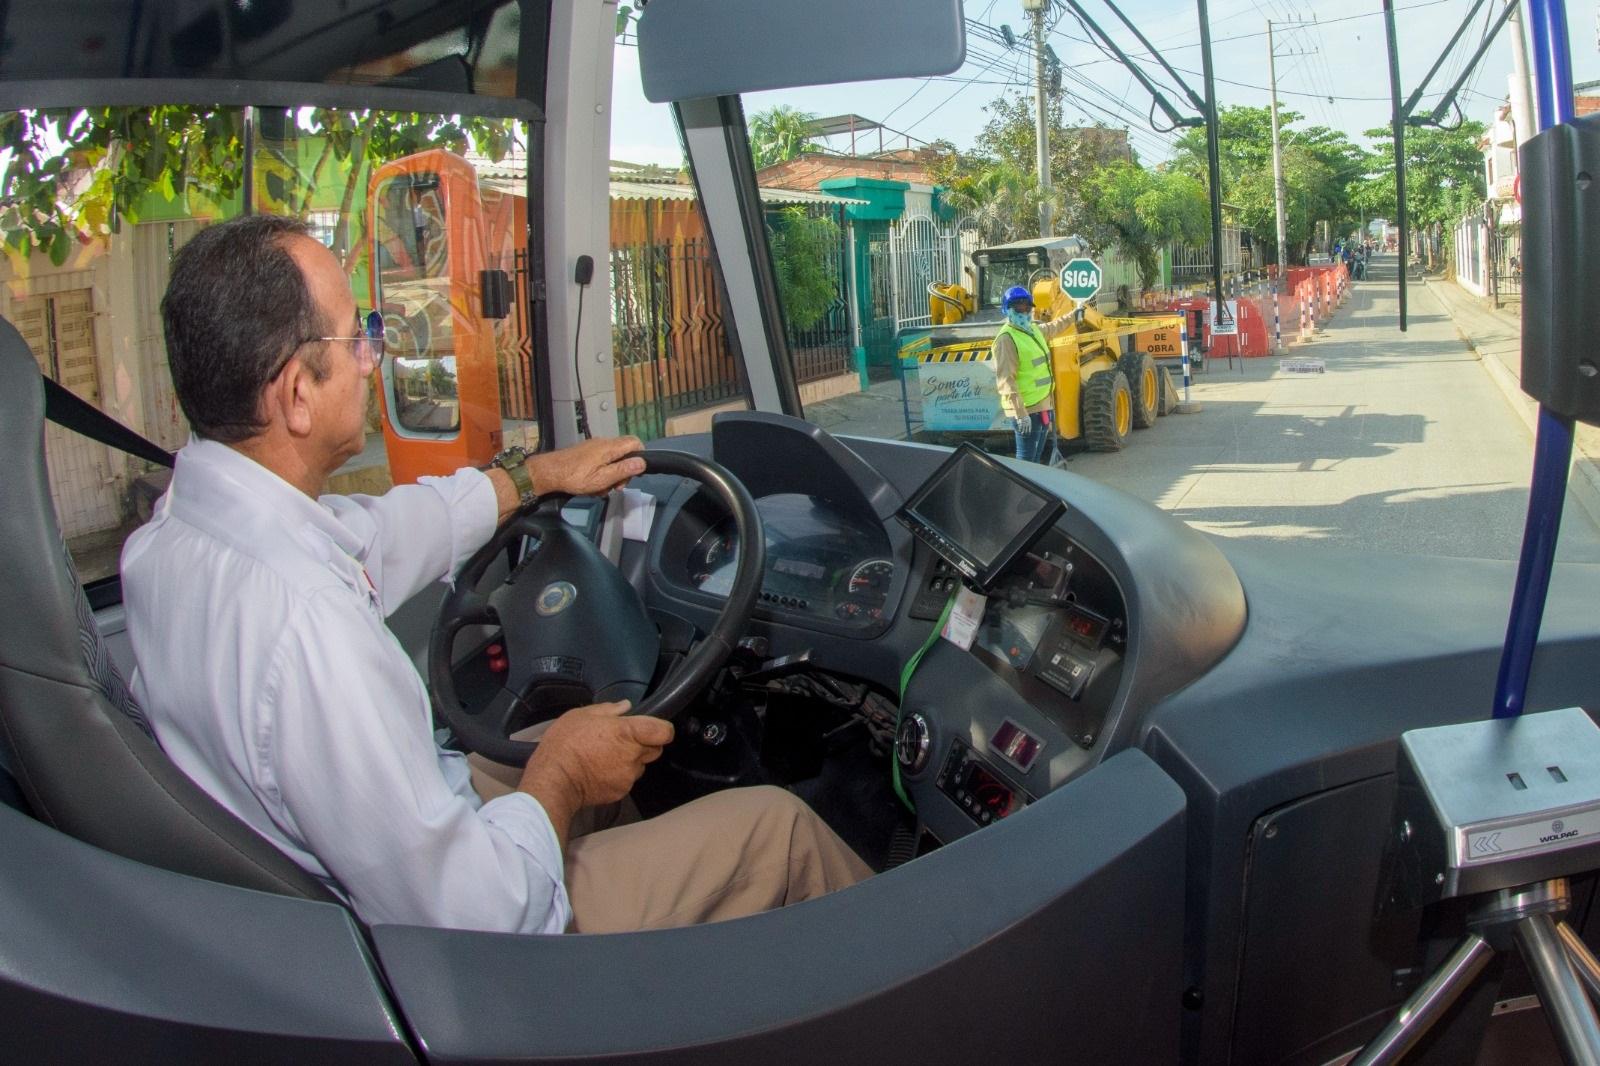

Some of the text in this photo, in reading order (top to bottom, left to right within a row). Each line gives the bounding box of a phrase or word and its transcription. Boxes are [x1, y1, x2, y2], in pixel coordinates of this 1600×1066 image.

[1063, 270, 1098, 288] SIGA
[1154, 333, 1167, 341] DE
[1147, 344, 1175, 353] OBRA
[923, 376, 970, 396] Somos
[934, 385, 982, 407] parte de ti
[1539, 829, 1579, 843] WOLPAC
